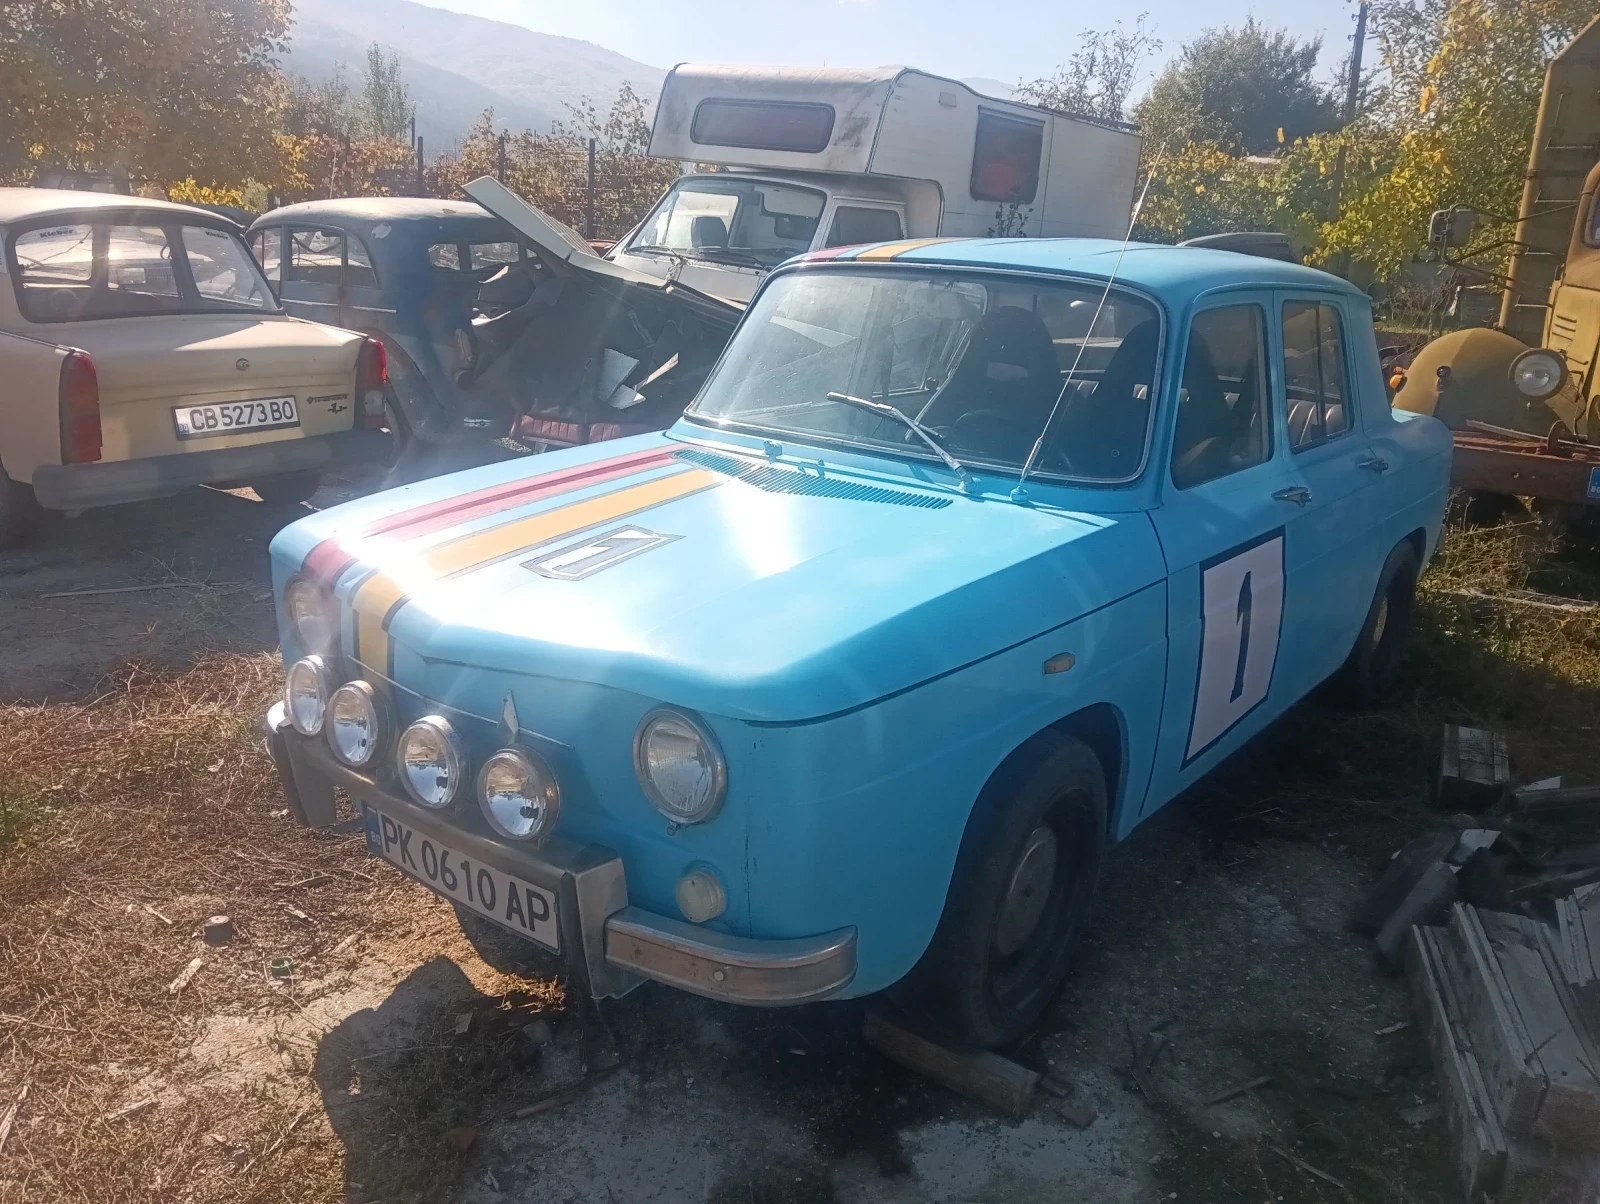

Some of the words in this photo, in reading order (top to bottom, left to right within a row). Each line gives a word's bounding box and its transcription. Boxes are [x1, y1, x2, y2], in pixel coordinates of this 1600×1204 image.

[40, 229, 73, 238] Kleber
[189, 408, 218, 431] CB
[219, 403, 268, 427] 5273
[1229, 570, 1253, 704] 1
[371, 831, 382, 846] BG
[380, 813, 418, 872] PK
[421, 839, 497, 912] 0610
[506, 881, 550, 931] AP
